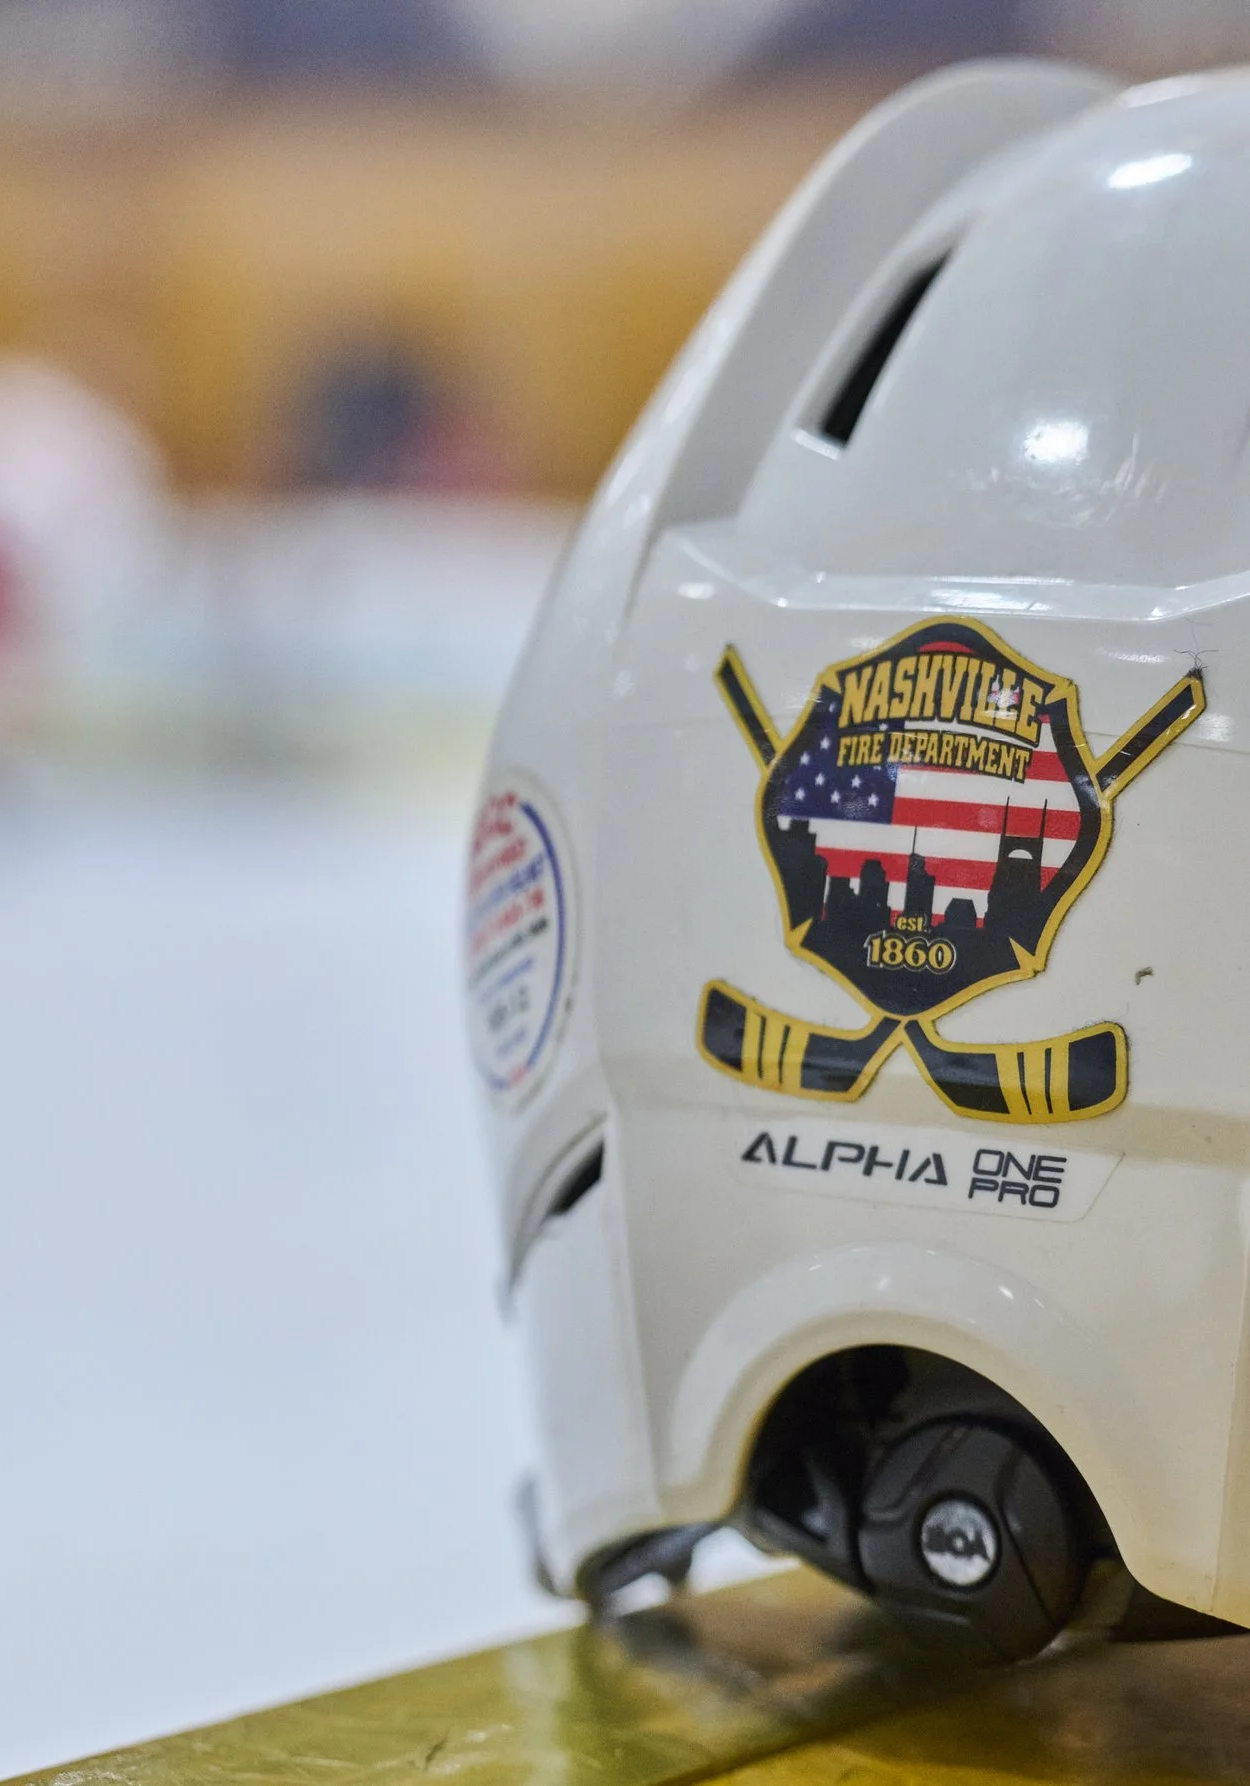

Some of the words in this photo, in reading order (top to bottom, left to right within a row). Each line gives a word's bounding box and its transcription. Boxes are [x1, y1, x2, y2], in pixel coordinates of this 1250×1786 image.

[838, 654, 1044, 742] NASHVILLE
[837, 733, 885, 767] FIRE
[887, 731, 1030, 781] DEPARTMENT
[867, 935, 954, 971] 1860
[741, 1131, 947, 1186] ALPHA
[972, 1149, 1067, 1184] ONE
[967, 1177, 1061, 1208] PRO
